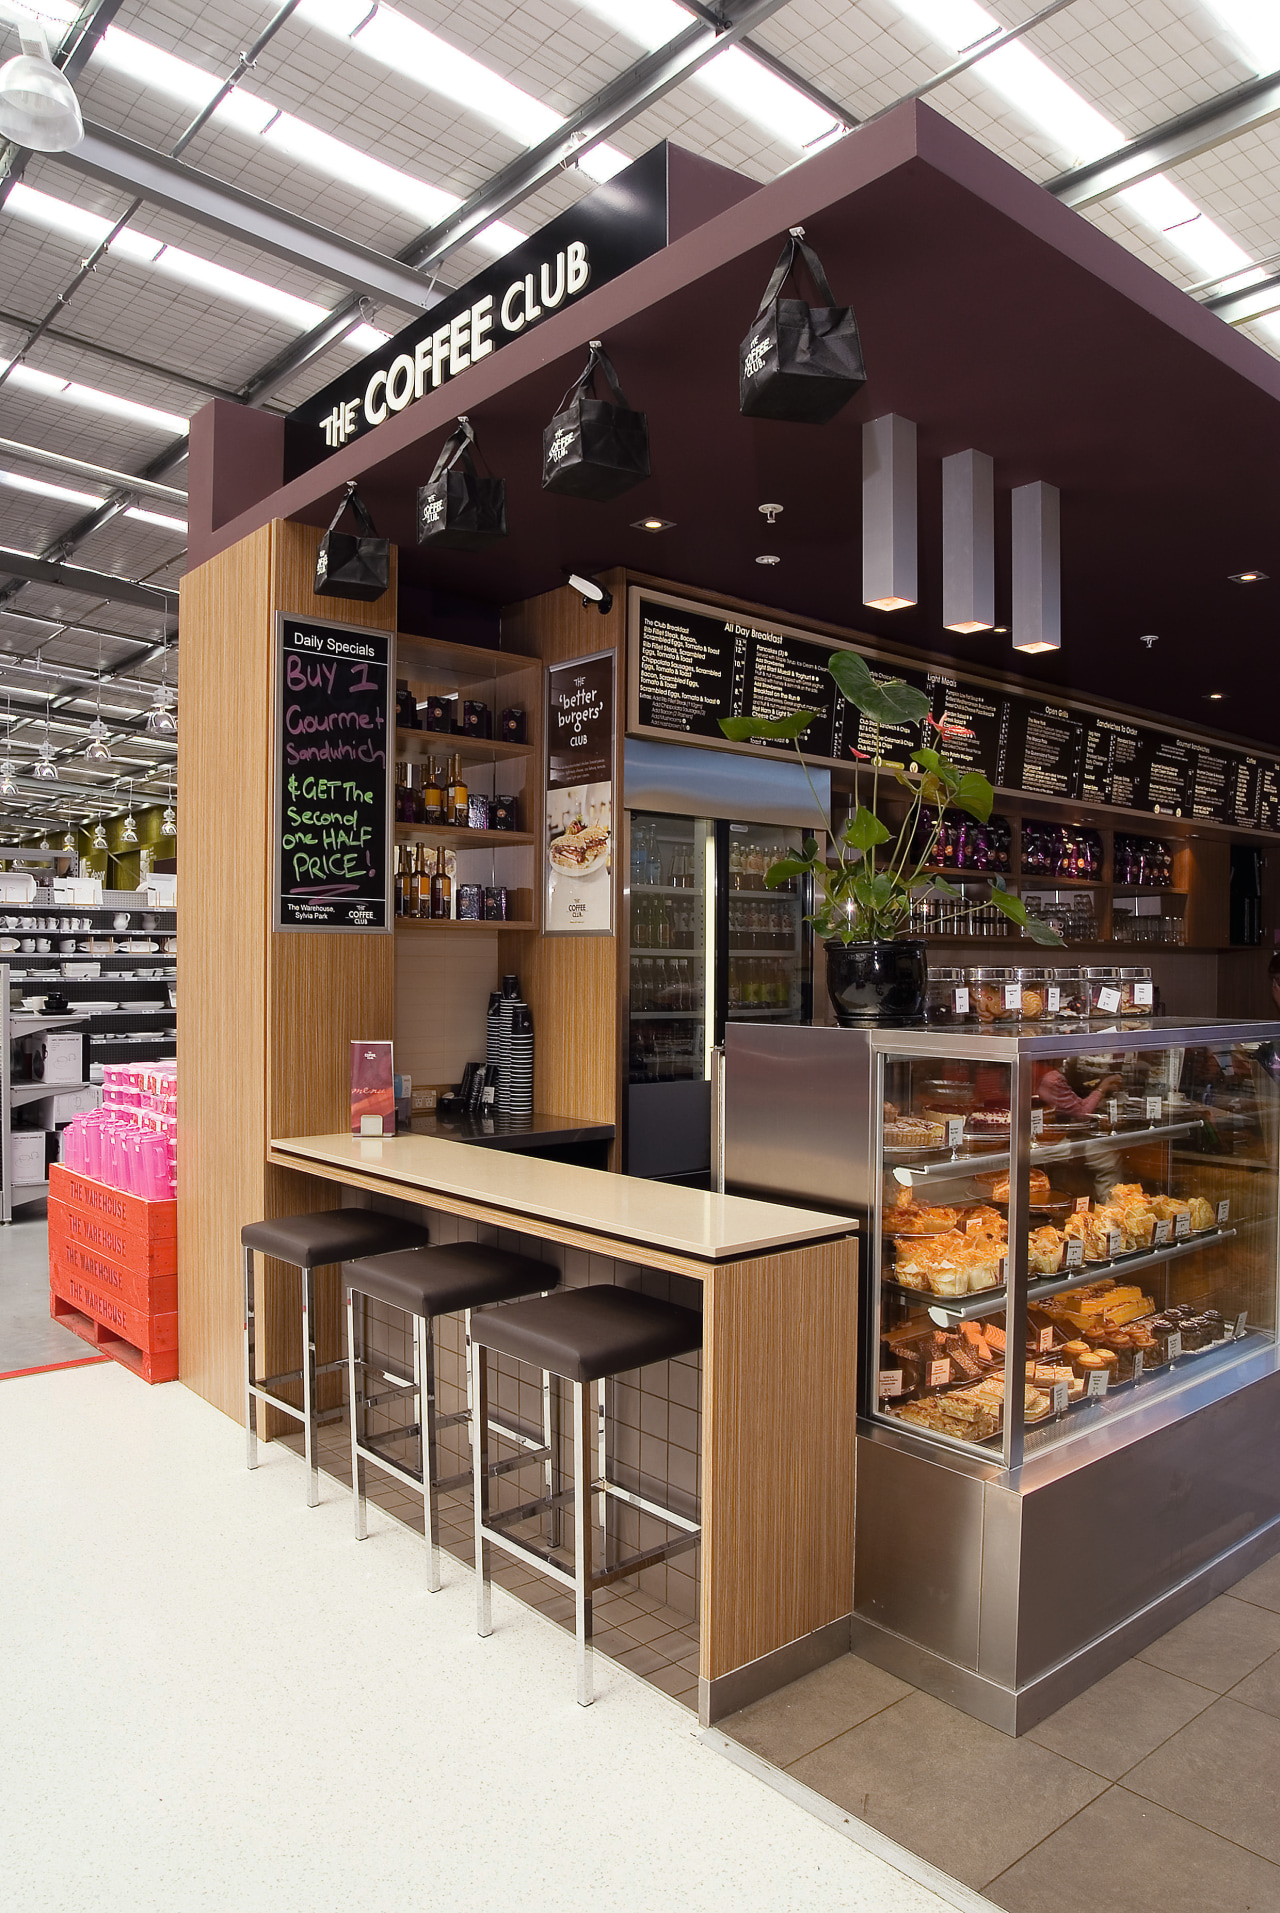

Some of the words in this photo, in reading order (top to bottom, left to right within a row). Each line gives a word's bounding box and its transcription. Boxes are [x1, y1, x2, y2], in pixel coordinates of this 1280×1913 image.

[320, 398, 361, 448] THE
[364, 294, 495, 426] COFFEE
[500, 240, 592, 332] CLUB
[644, 618, 653, 626] The
[654, 620, 666, 628] Club
[667, 623, 689, 634] Breakfast
[724, 622, 733, 632] All
[735, 625, 750, 638] Day
[751, 628, 782, 644] Breakfast
[294, 632, 324, 650] Daily
[326, 638, 374, 656] Specials
[643, 633, 670, 644] Scrambled
[685, 642, 703, 651] Tomato
[708, 647, 720, 655] Toast
[679, 648, 705, 660] Scrambled
[756, 644, 777, 655] Pancakes
[657, 650, 675, 659] Tomato
[680, 655, 692, 663] Toast
[348, 663, 378, 692] 1
[656, 665, 674, 674] Tomato
[659, 674, 686, 684] Scrambled
[696, 666, 721, 677] Scrambled
[574, 676, 586, 687] THE
[640, 677, 659, 685] Tomato
[664, 681, 677, 689] Toast
[754, 686, 774, 696] Breakfast
[942, 676, 957, 688] Meals
[640, 684, 667, 695] Scrambled
[682, 692, 699, 701] Tomato
[704, 696, 716, 704] Toast
[286, 704, 384, 734] Gourmet
[570, 734, 588, 747] CLUB
[286, 738, 386, 770] Sandwhich
[302, 776, 342, 801] GET
[343, 782, 374, 804] The
[287, 806, 358, 831] Second
[282, 832, 318, 850] one
[322, 826, 372, 850] HALF
[295, 912, 313, 920] Sylvia
[314, 912, 328, 920] Park
[348, 910, 374, 919] COFFEE
[70, 1180, 83, 1202] THE
[84, 1186, 127, 1222] WAREHOUSE
[69, 1214, 82, 1235] THE
[83, 1220, 126, 1257] WAREHOUSE
[66, 1245, 78, 1266] THE
[80, 1252, 123, 1290] WAREHOUSE
[70, 1279, 83, 1302] THE
[84, 1286, 127, 1330] WAREHOUSE
